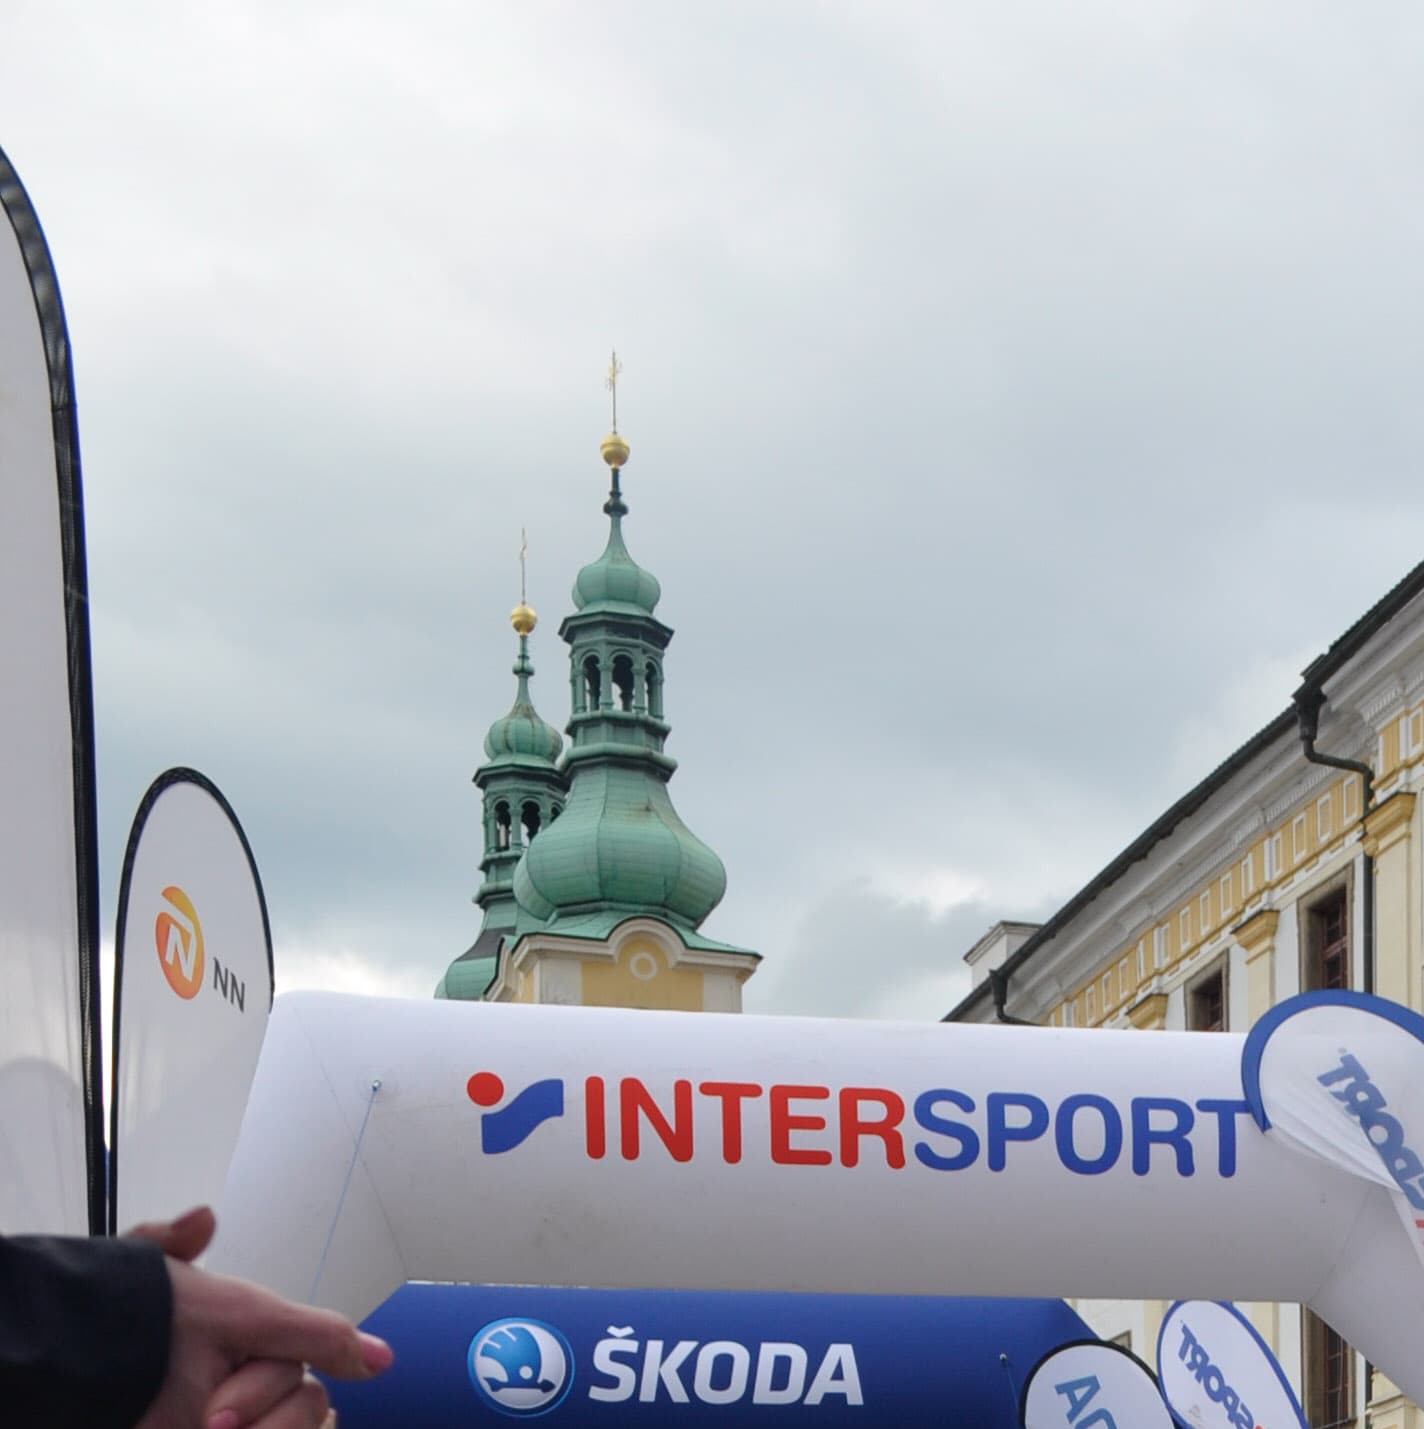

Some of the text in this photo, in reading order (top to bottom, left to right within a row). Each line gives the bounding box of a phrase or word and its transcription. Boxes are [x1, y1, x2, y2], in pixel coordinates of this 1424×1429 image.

[213, 956, 246, 1014] NN
[584, 1075, 1250, 1179] INTERSPORT
[588, 1325, 865, 1407] ŠKODA
